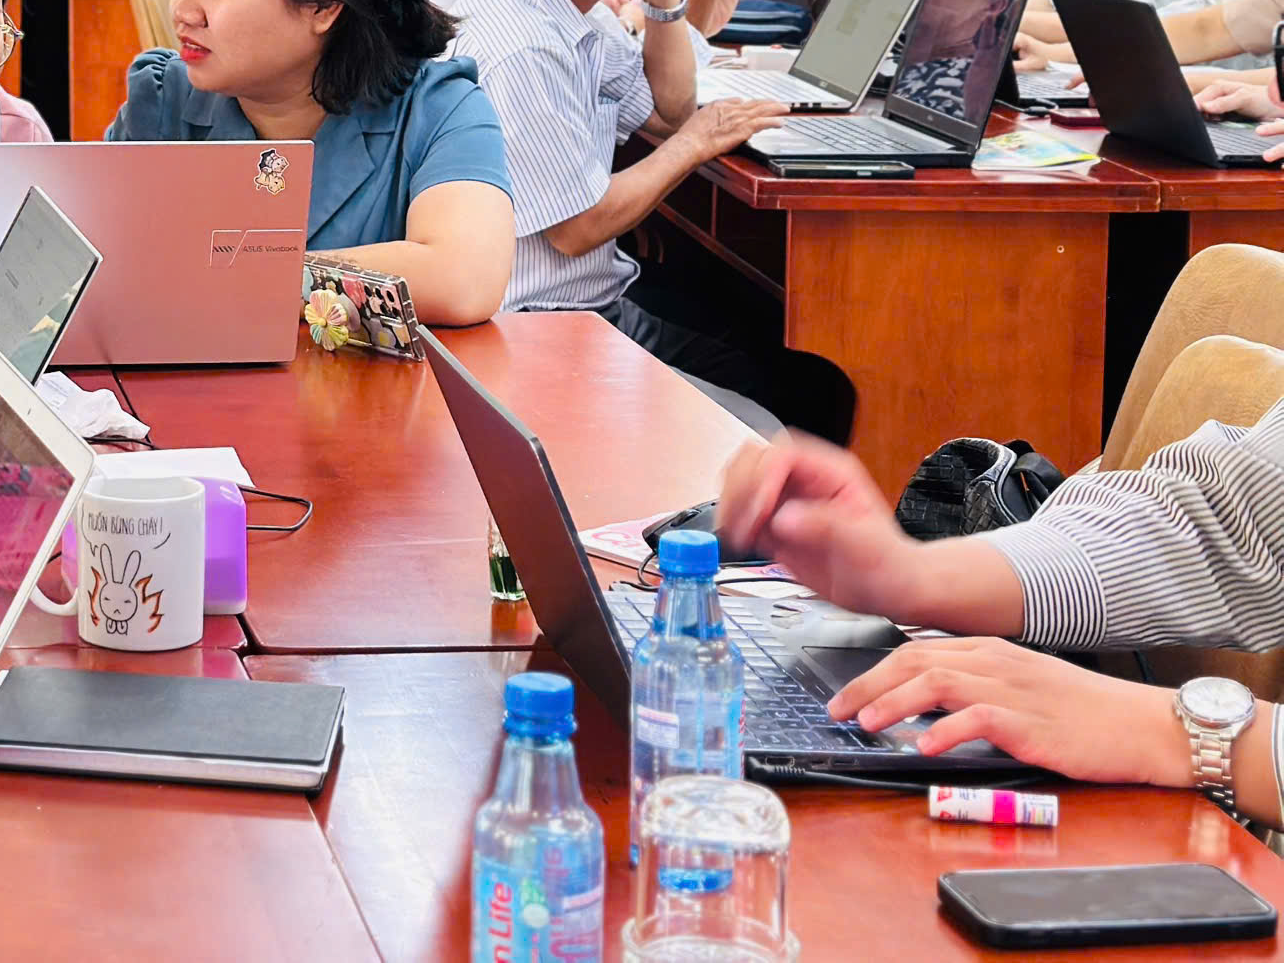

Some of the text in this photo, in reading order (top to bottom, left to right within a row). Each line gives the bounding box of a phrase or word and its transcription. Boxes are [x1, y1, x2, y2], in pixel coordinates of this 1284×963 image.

[243, 245, 299, 253] ASUS Vivobook
[489, 881, 513, 938] Life
